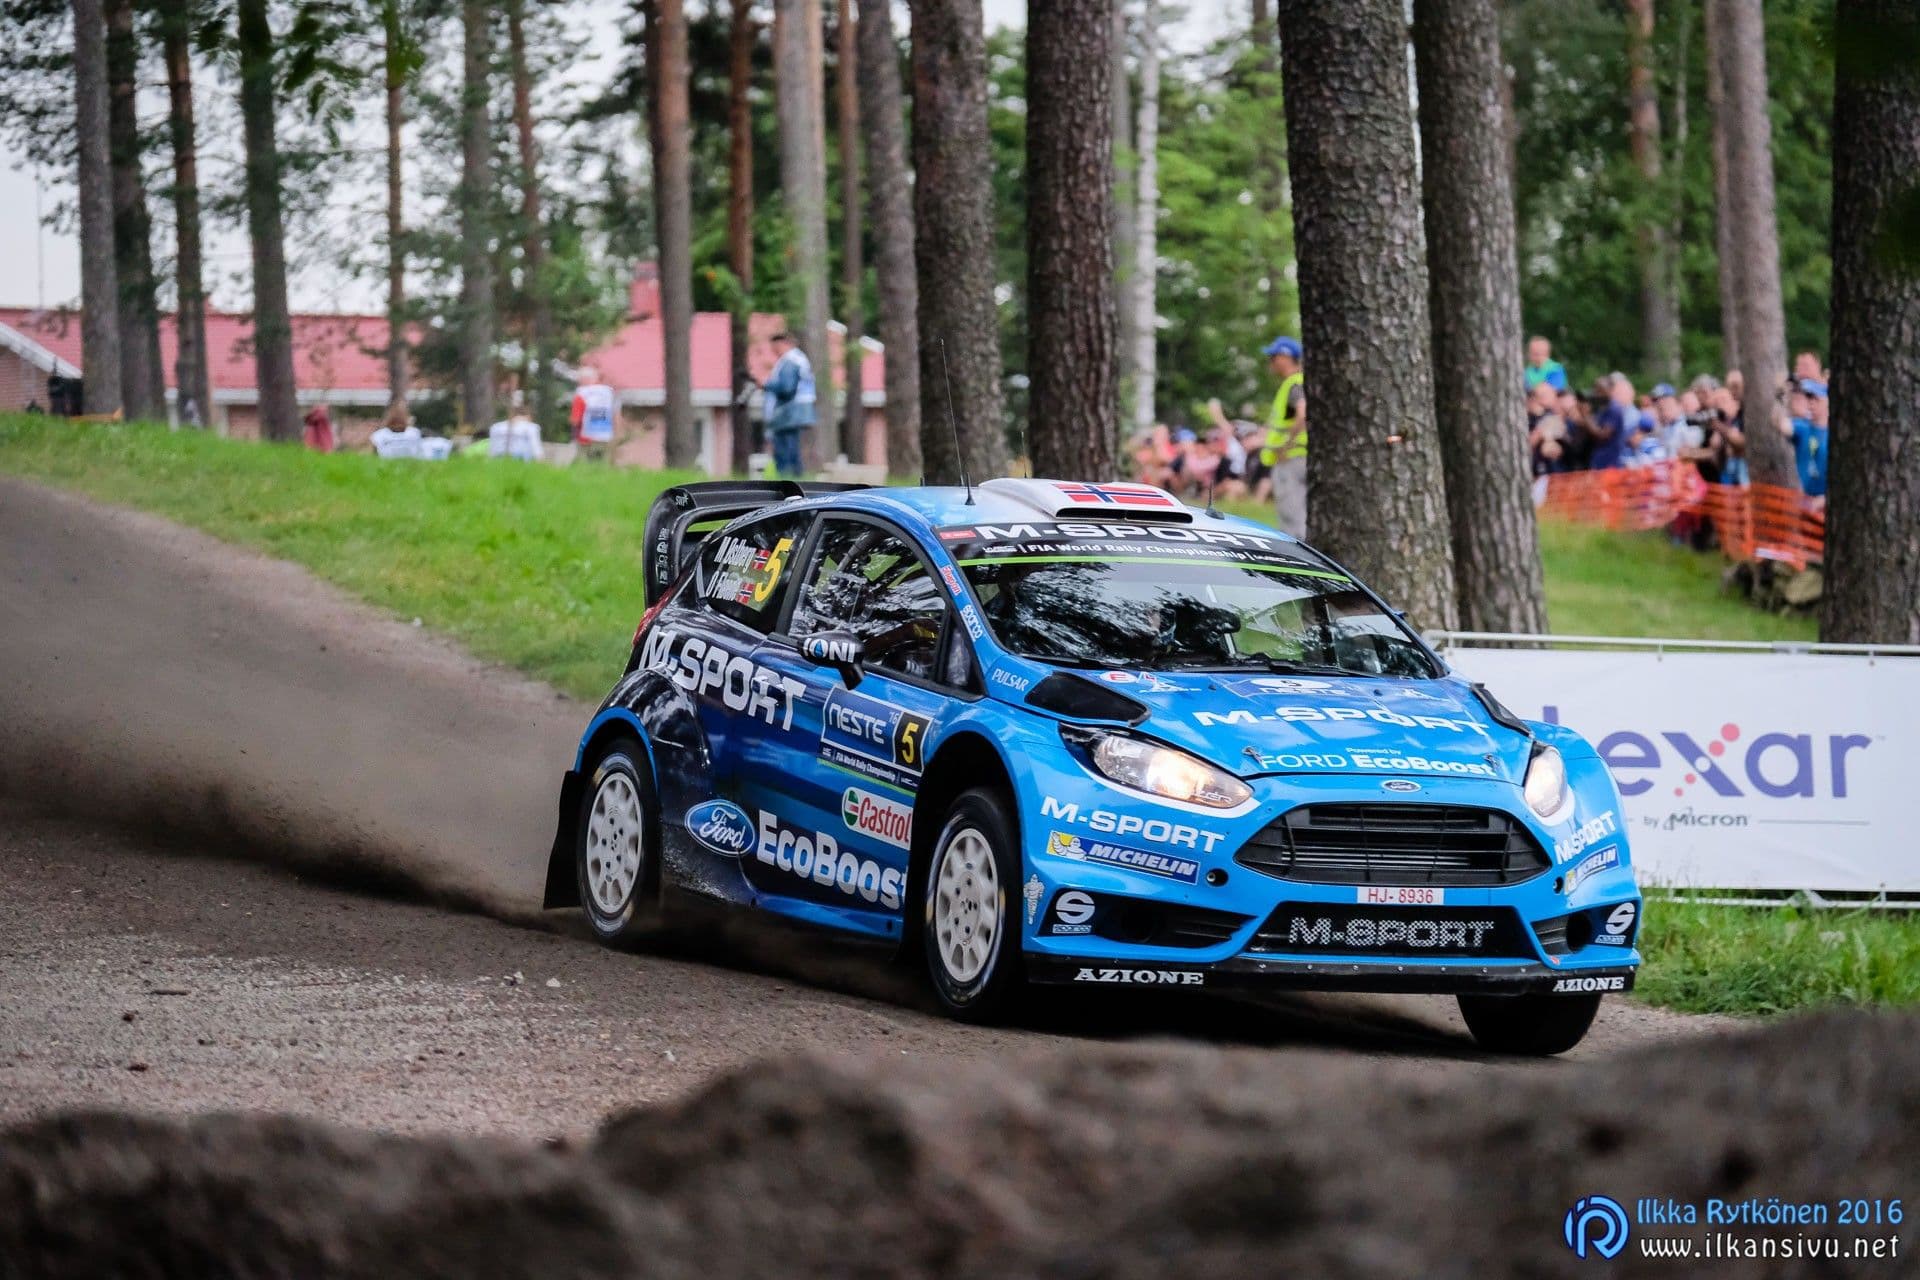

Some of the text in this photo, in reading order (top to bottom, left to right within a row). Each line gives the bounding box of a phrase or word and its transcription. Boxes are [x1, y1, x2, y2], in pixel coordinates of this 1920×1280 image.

[974, 524, 1272, 550] M-SPORT
[1031, 543, 1246, 559] FIA World Rally Championship
[755, 538, 793, 601] 5
[638, 625, 806, 732] M-SPORT
[992, 668, 1029, 691] PULSAR
[829, 703, 886, 744] NESTE
[1192, 706, 1489, 735] M-SPORT
[902, 722, 919, 763] 5
[1346, 748, 1402, 756] Powered by
[1542, 705, 1873, 798] exar
[1259, 754, 1497, 777] FORD EcoBoost
[699, 805, 745, 850] Ford
[857, 796, 911, 843] Castrol
[1040, 797, 1225, 852] M-SPORT
[1663, 806, 1748, 831] Micron
[1554, 810, 1616, 864] M-SPORT
[1089, 843, 1197, 876] MICHELIN
[1398, 888, 1434, 903] 8936
[1289, 917, 1494, 947] M-SPORT
[1074, 968, 1204, 985] AZIONE
[1553, 976, 1625, 992] AZIONE
